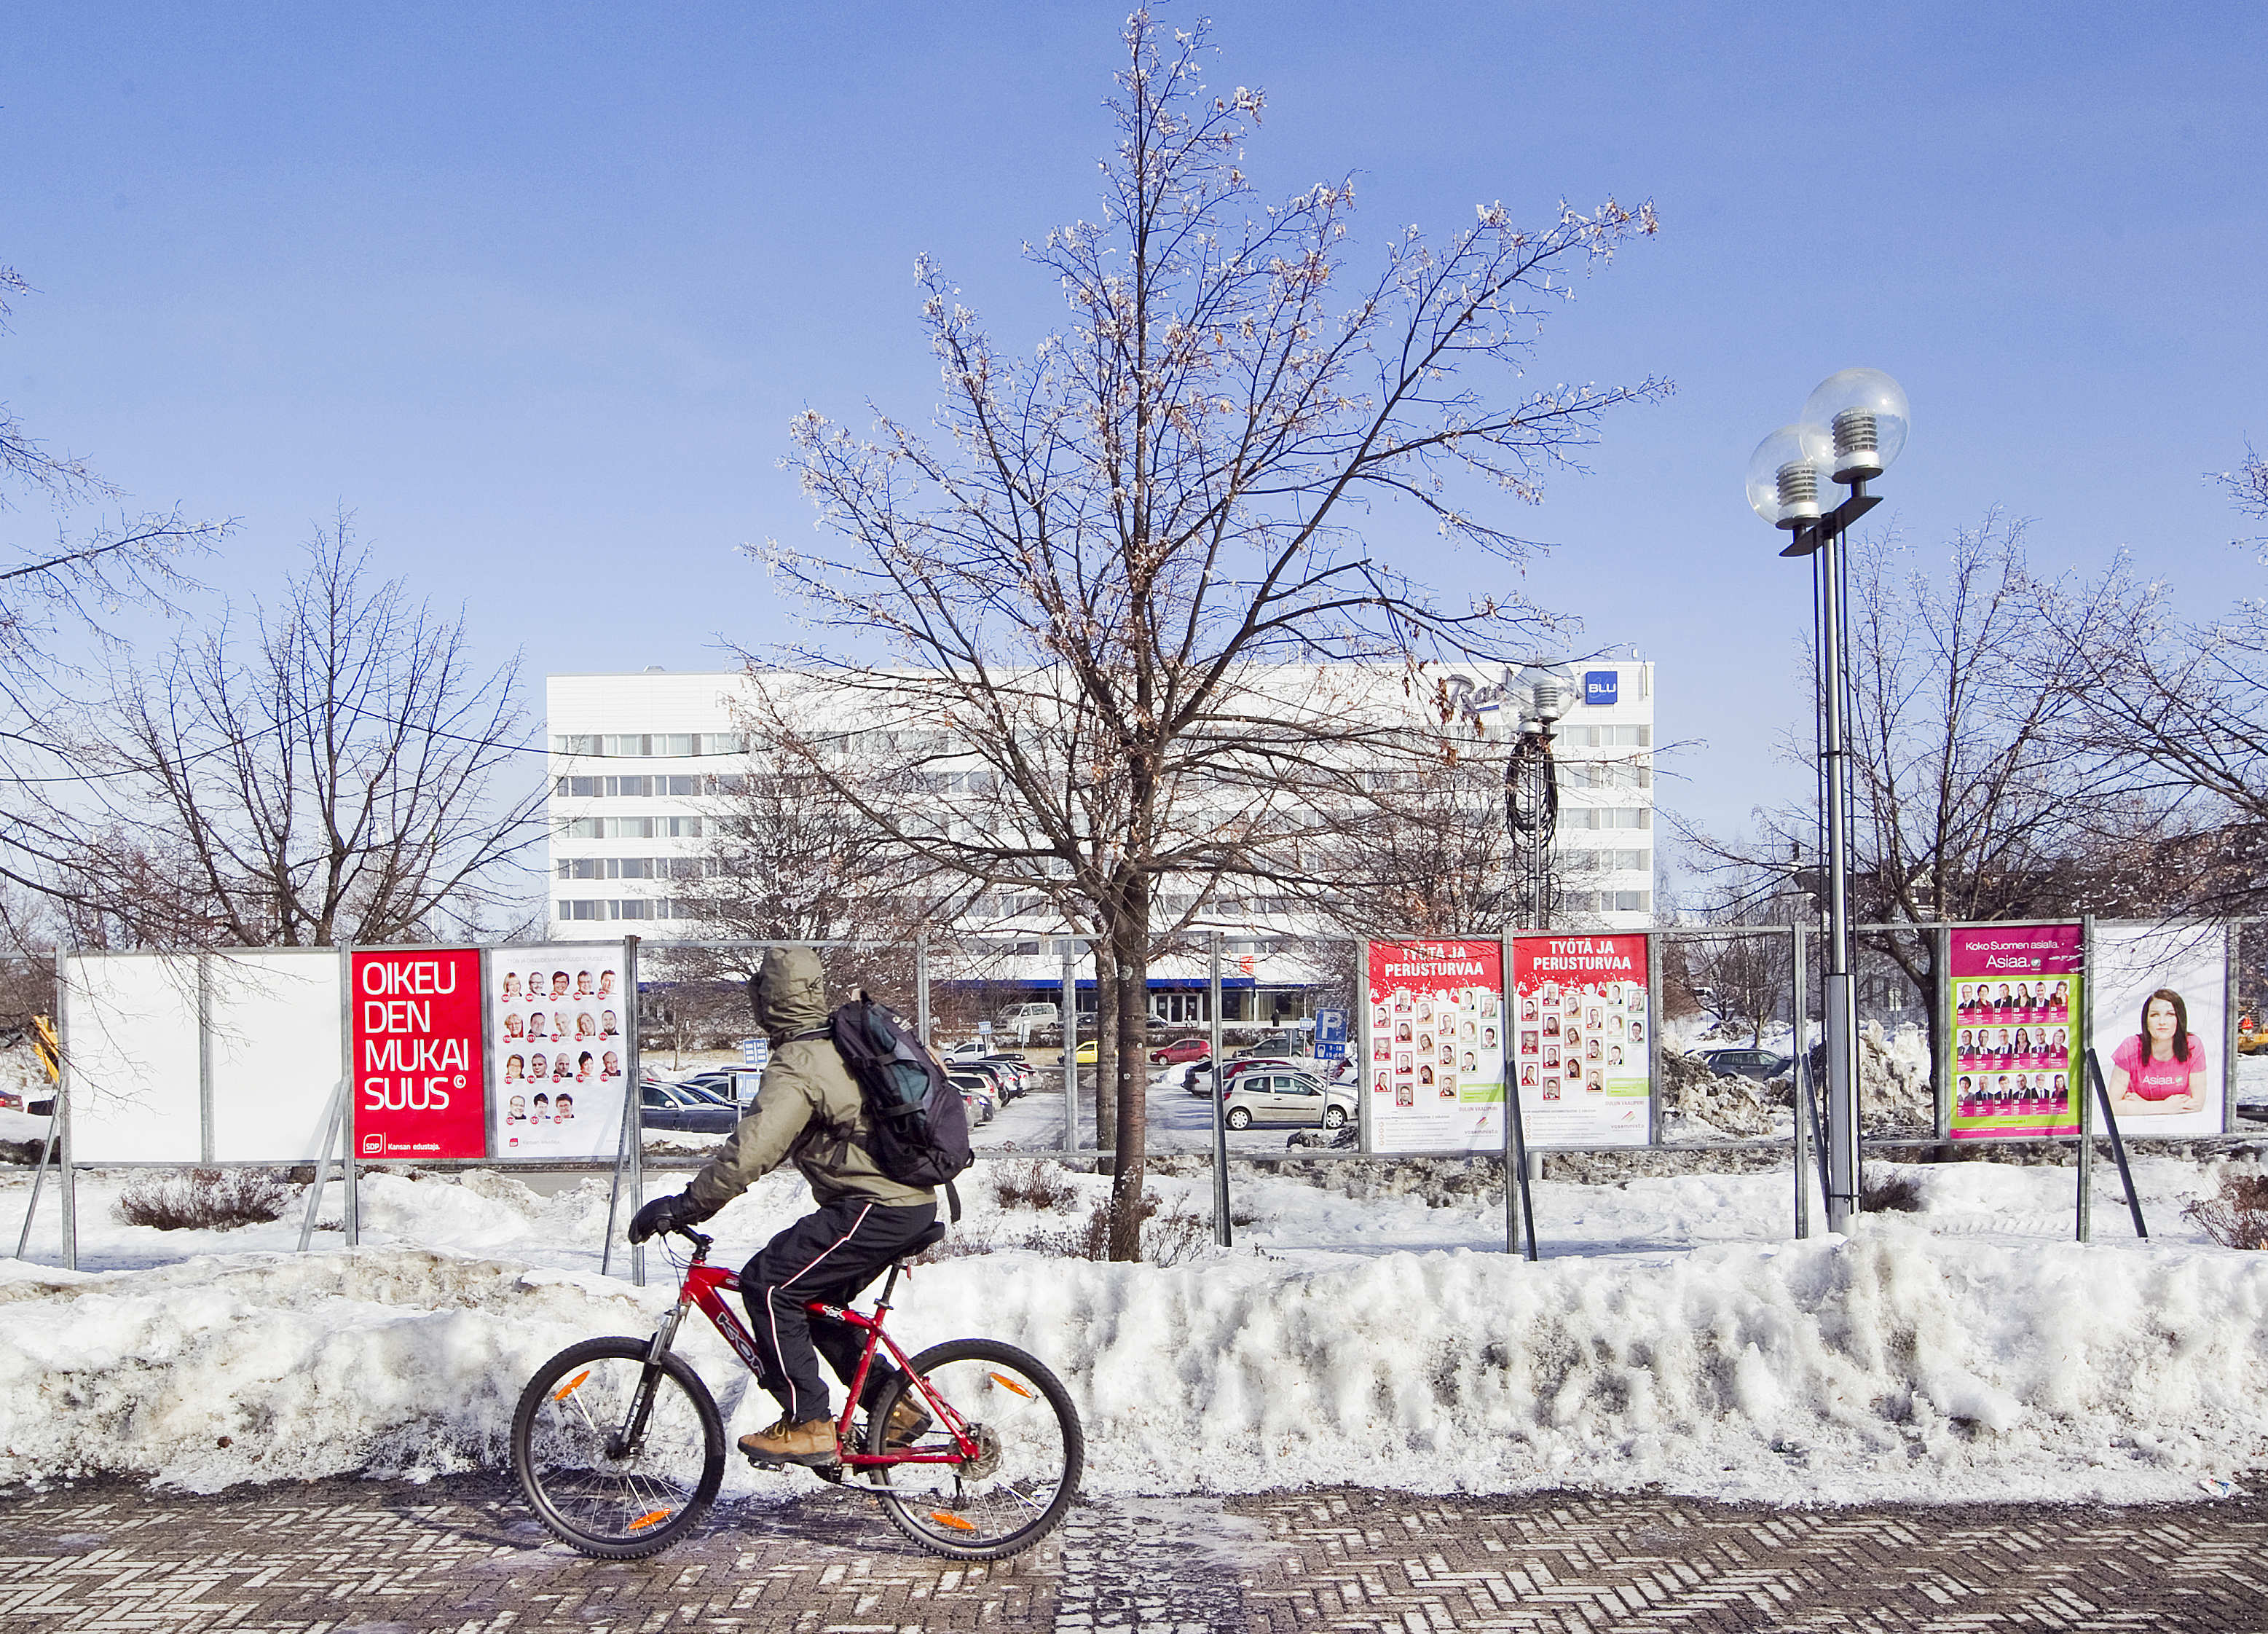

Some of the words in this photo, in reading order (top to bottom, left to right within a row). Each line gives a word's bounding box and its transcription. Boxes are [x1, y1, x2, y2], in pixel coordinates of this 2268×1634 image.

[1588, 683, 1616, 693] BLU
[1401, 943, 1445, 960] TYÖTÄ
[1448, 946, 1467, 959] JA
[1549, 938, 1592, 954] TYÖTÄ
[1596, 940, 1615, 954] JA
[1966, 942, 1990, 951] Koko
[1991, 940, 2029, 950] Suomen
[2031, 940, 2060, 948] asialla.
[1533, 956, 1631, 971] PERUSTURVAA
[1985, 954, 2031, 969] Asiaa.
[1385, 962, 1484, 977] PERUSTURVAA
[363, 961, 456, 995] OIKEU
[364, 1000, 430, 1034] DEN
[1321, 1010, 1343, 1039] P
[365, 1038, 468, 1072] MUKAI
[2142, 1075, 2176, 1085] Asiaa.
[412, 1143, 440, 1152] edustaja.
